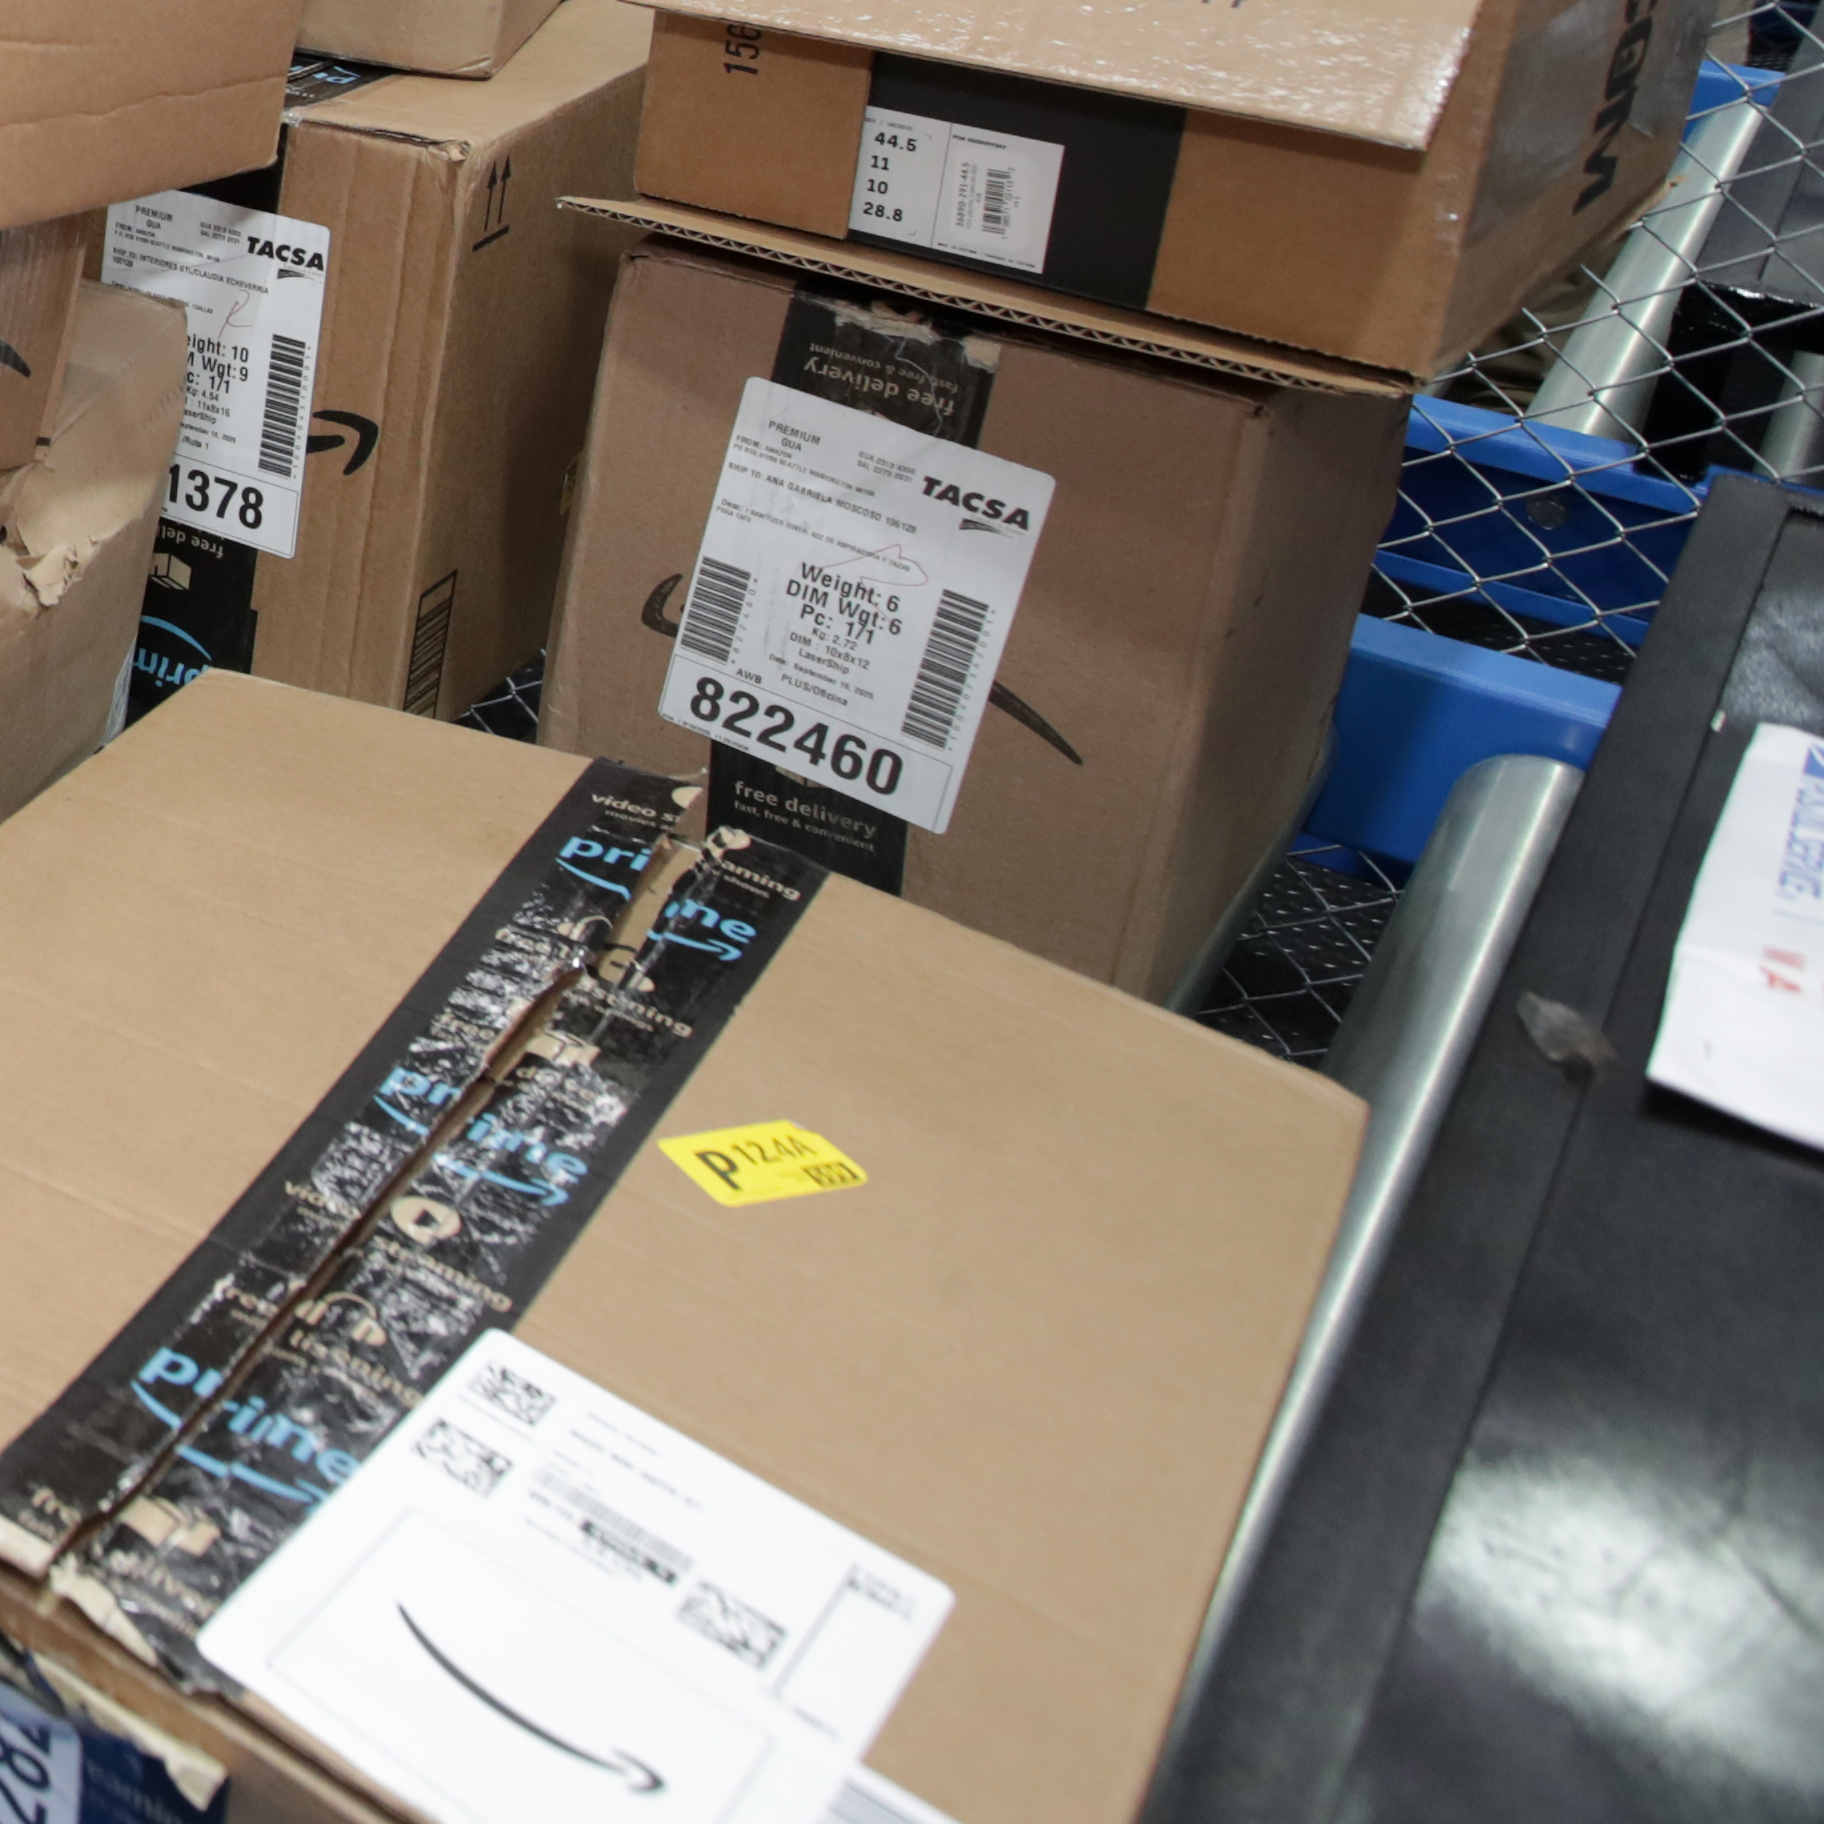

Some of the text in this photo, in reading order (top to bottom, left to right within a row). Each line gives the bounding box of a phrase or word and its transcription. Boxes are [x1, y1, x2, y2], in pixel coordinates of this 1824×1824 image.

[874, 132, 917, 152] 44.5
[870, 155, 890, 171] 11
[867, 179, 888, 194] 10
[135, 205, 173, 222] PREMIUM
[146, 219, 161, 230] GUA
[863, 202, 903, 222] 28.8
[246, 236, 324, 272] TACSA
[139, 252, 269, 296] INTERIORES ECHEVERRIA
[231, 346, 249, 363] 10
[809, 343, 882, 372] convenient
[202, 356, 249, 382] Wgt: 9
[201, 389, 219, 402] 4.54
[209, 376, 231, 394] 1/1
[803, 356, 954, 416] free delivery
[736, 435, 762, 452] FROM:
[768, 421, 821, 445] PREMIUM
[781, 437, 802, 452] GUA
[168, 462, 263, 530] 1378
[728, 462, 883, 522] SHIP ANA GABRIELA MOSCOSO
[921, 476, 1030, 532] TACSA
[192, 533, 225, 559] free
[801, 562, 900, 612] Weight: 6
[786, 578, 902, 636] DIM Wgt: 6
[800, 604, 876, 646] Pc: 1/1
[811, 626, 858, 651] Kg: 2.72
[790, 632, 871, 670] DIM 10x8x12
[798, 648, 850, 676] LaserShip
[736, 668, 848, 707] AWB PLUS/Oficina
[793, 661, 838, 687] September
[689, 676, 903, 796] 822460
[591, 793, 657, 820] video
[734, 781, 878, 840] free delivery
[734, 799, 875, 854] fast, free convenient
[691, 1144, 742, 1191] P
